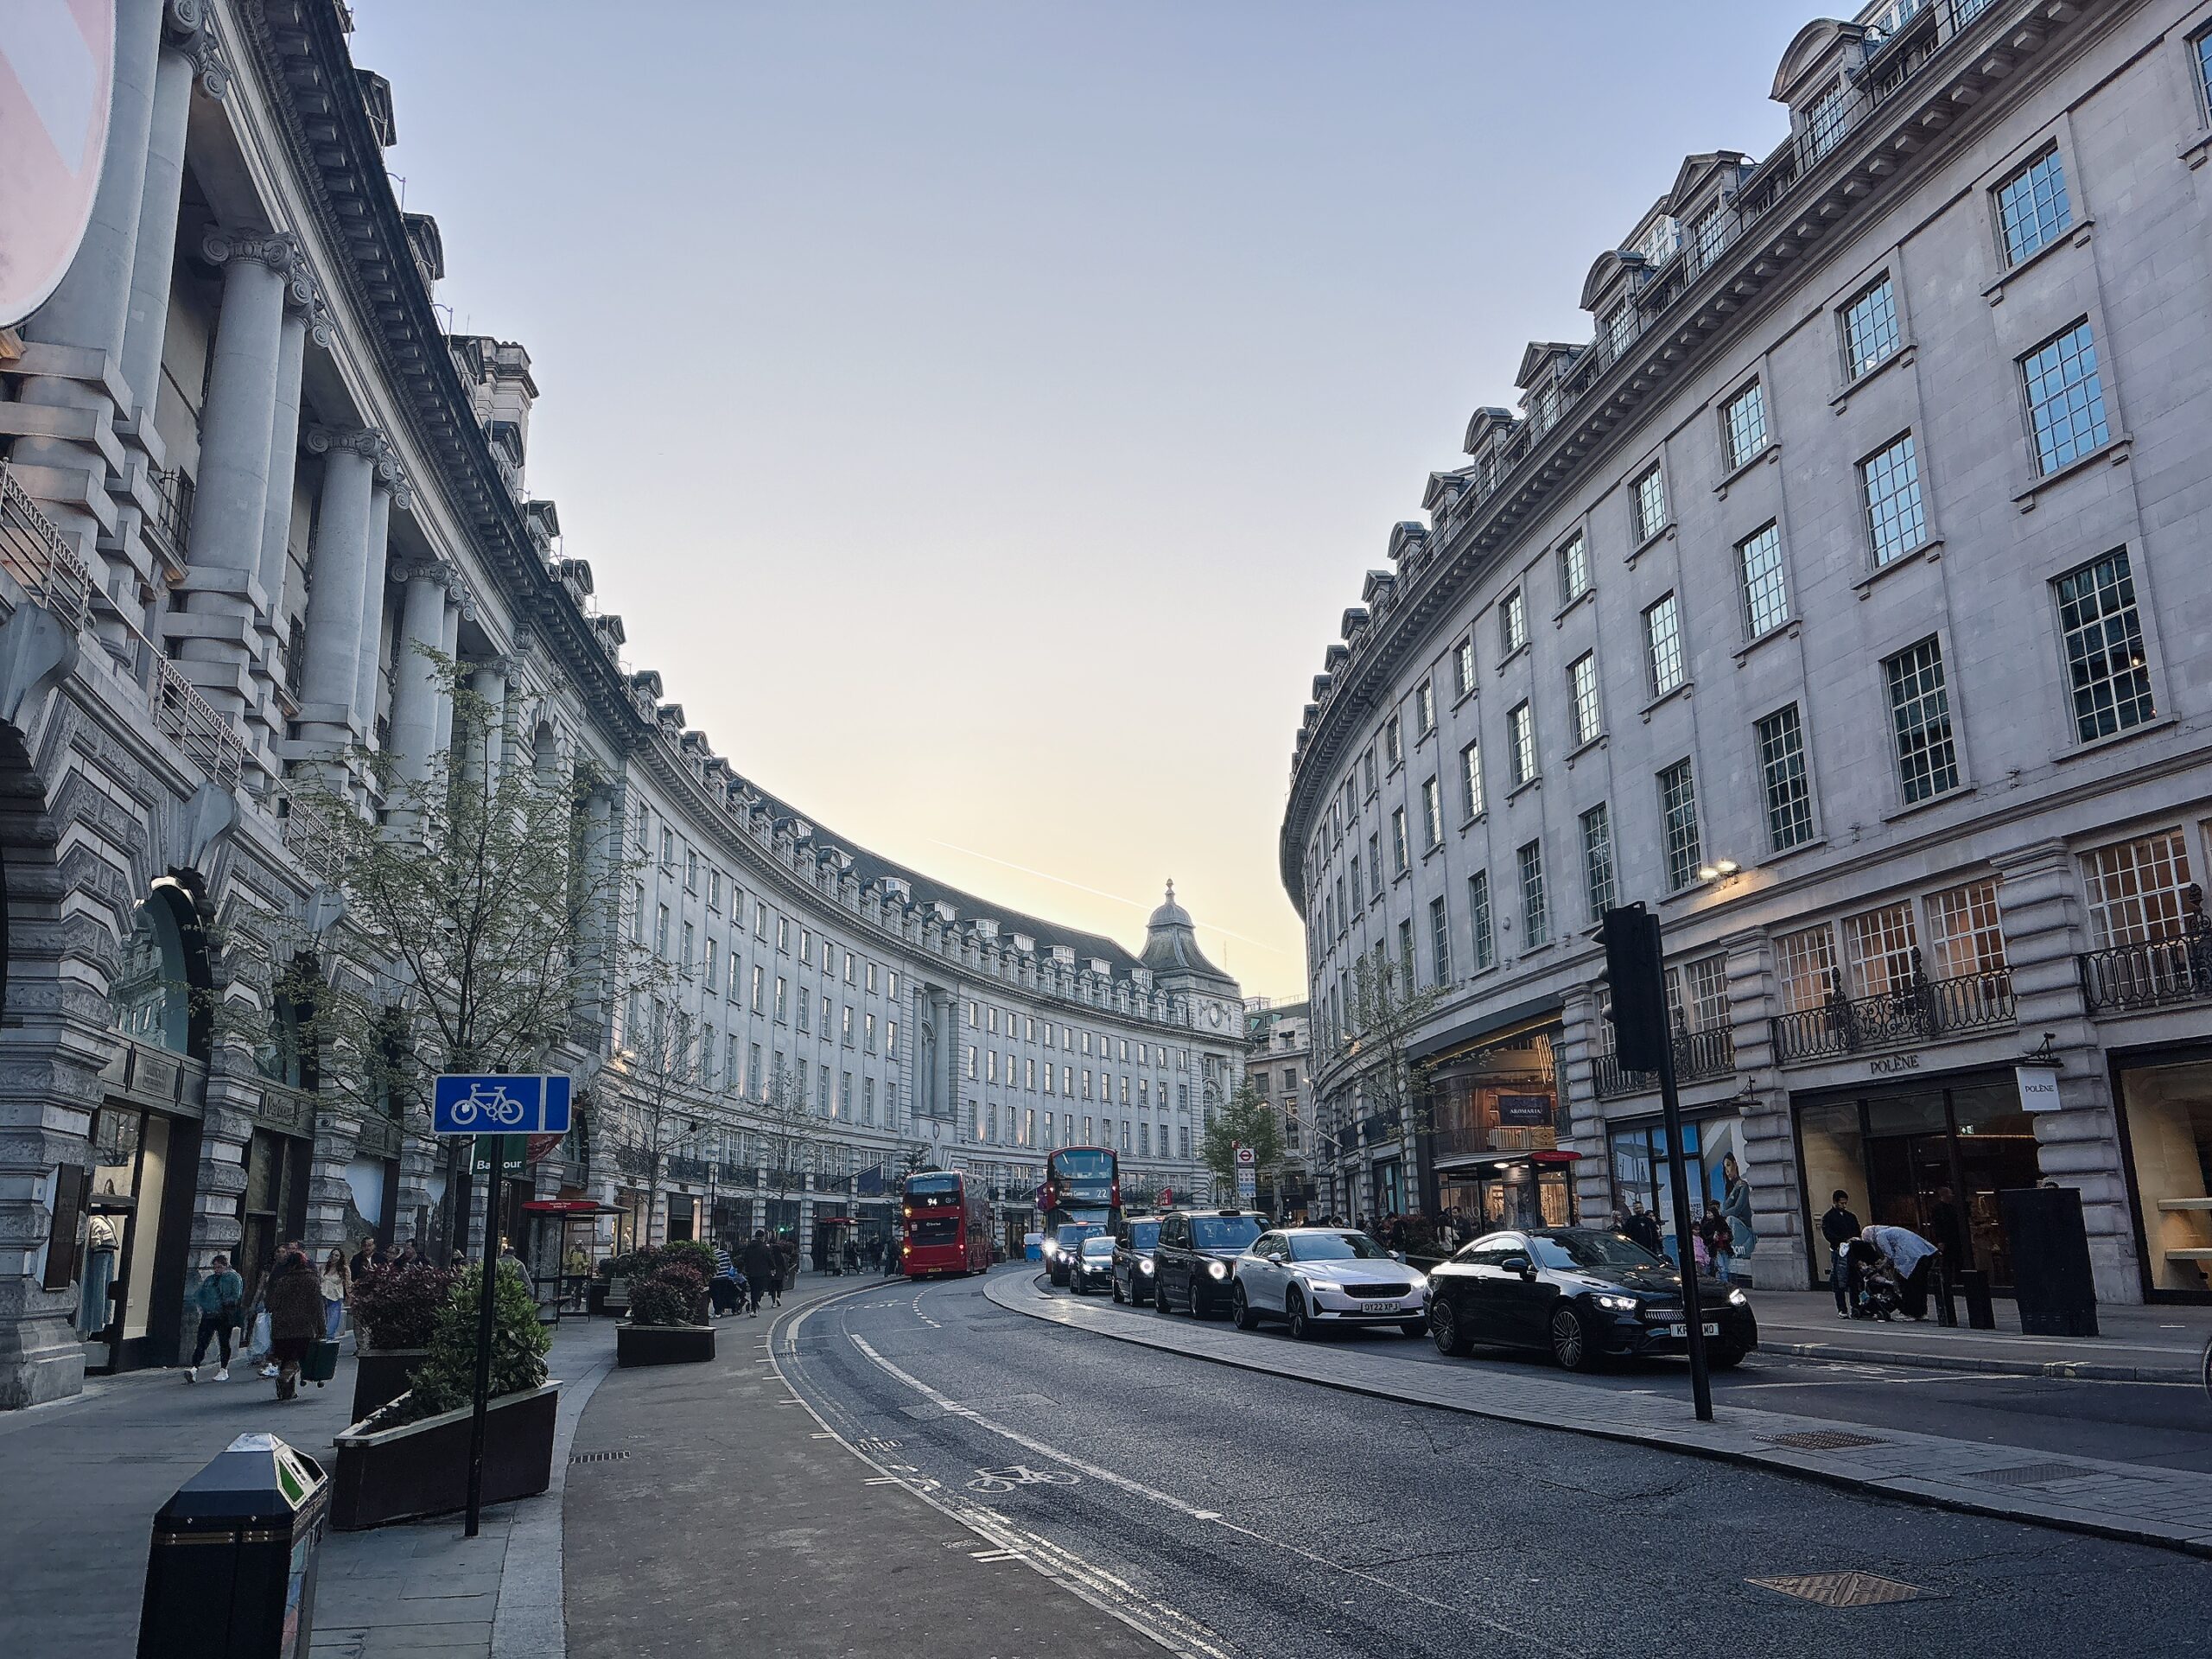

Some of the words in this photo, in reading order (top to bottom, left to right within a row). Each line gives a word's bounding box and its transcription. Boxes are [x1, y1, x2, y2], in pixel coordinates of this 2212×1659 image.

[1870, 1054, 1920, 1075] POLÈNE
[476, 1160, 523, 1170] Baour
[1096, 1189, 1108, 1198] 22
[927, 1198, 938, 1206] 94
[1384, 1302, 1398, 1311] XPJ
